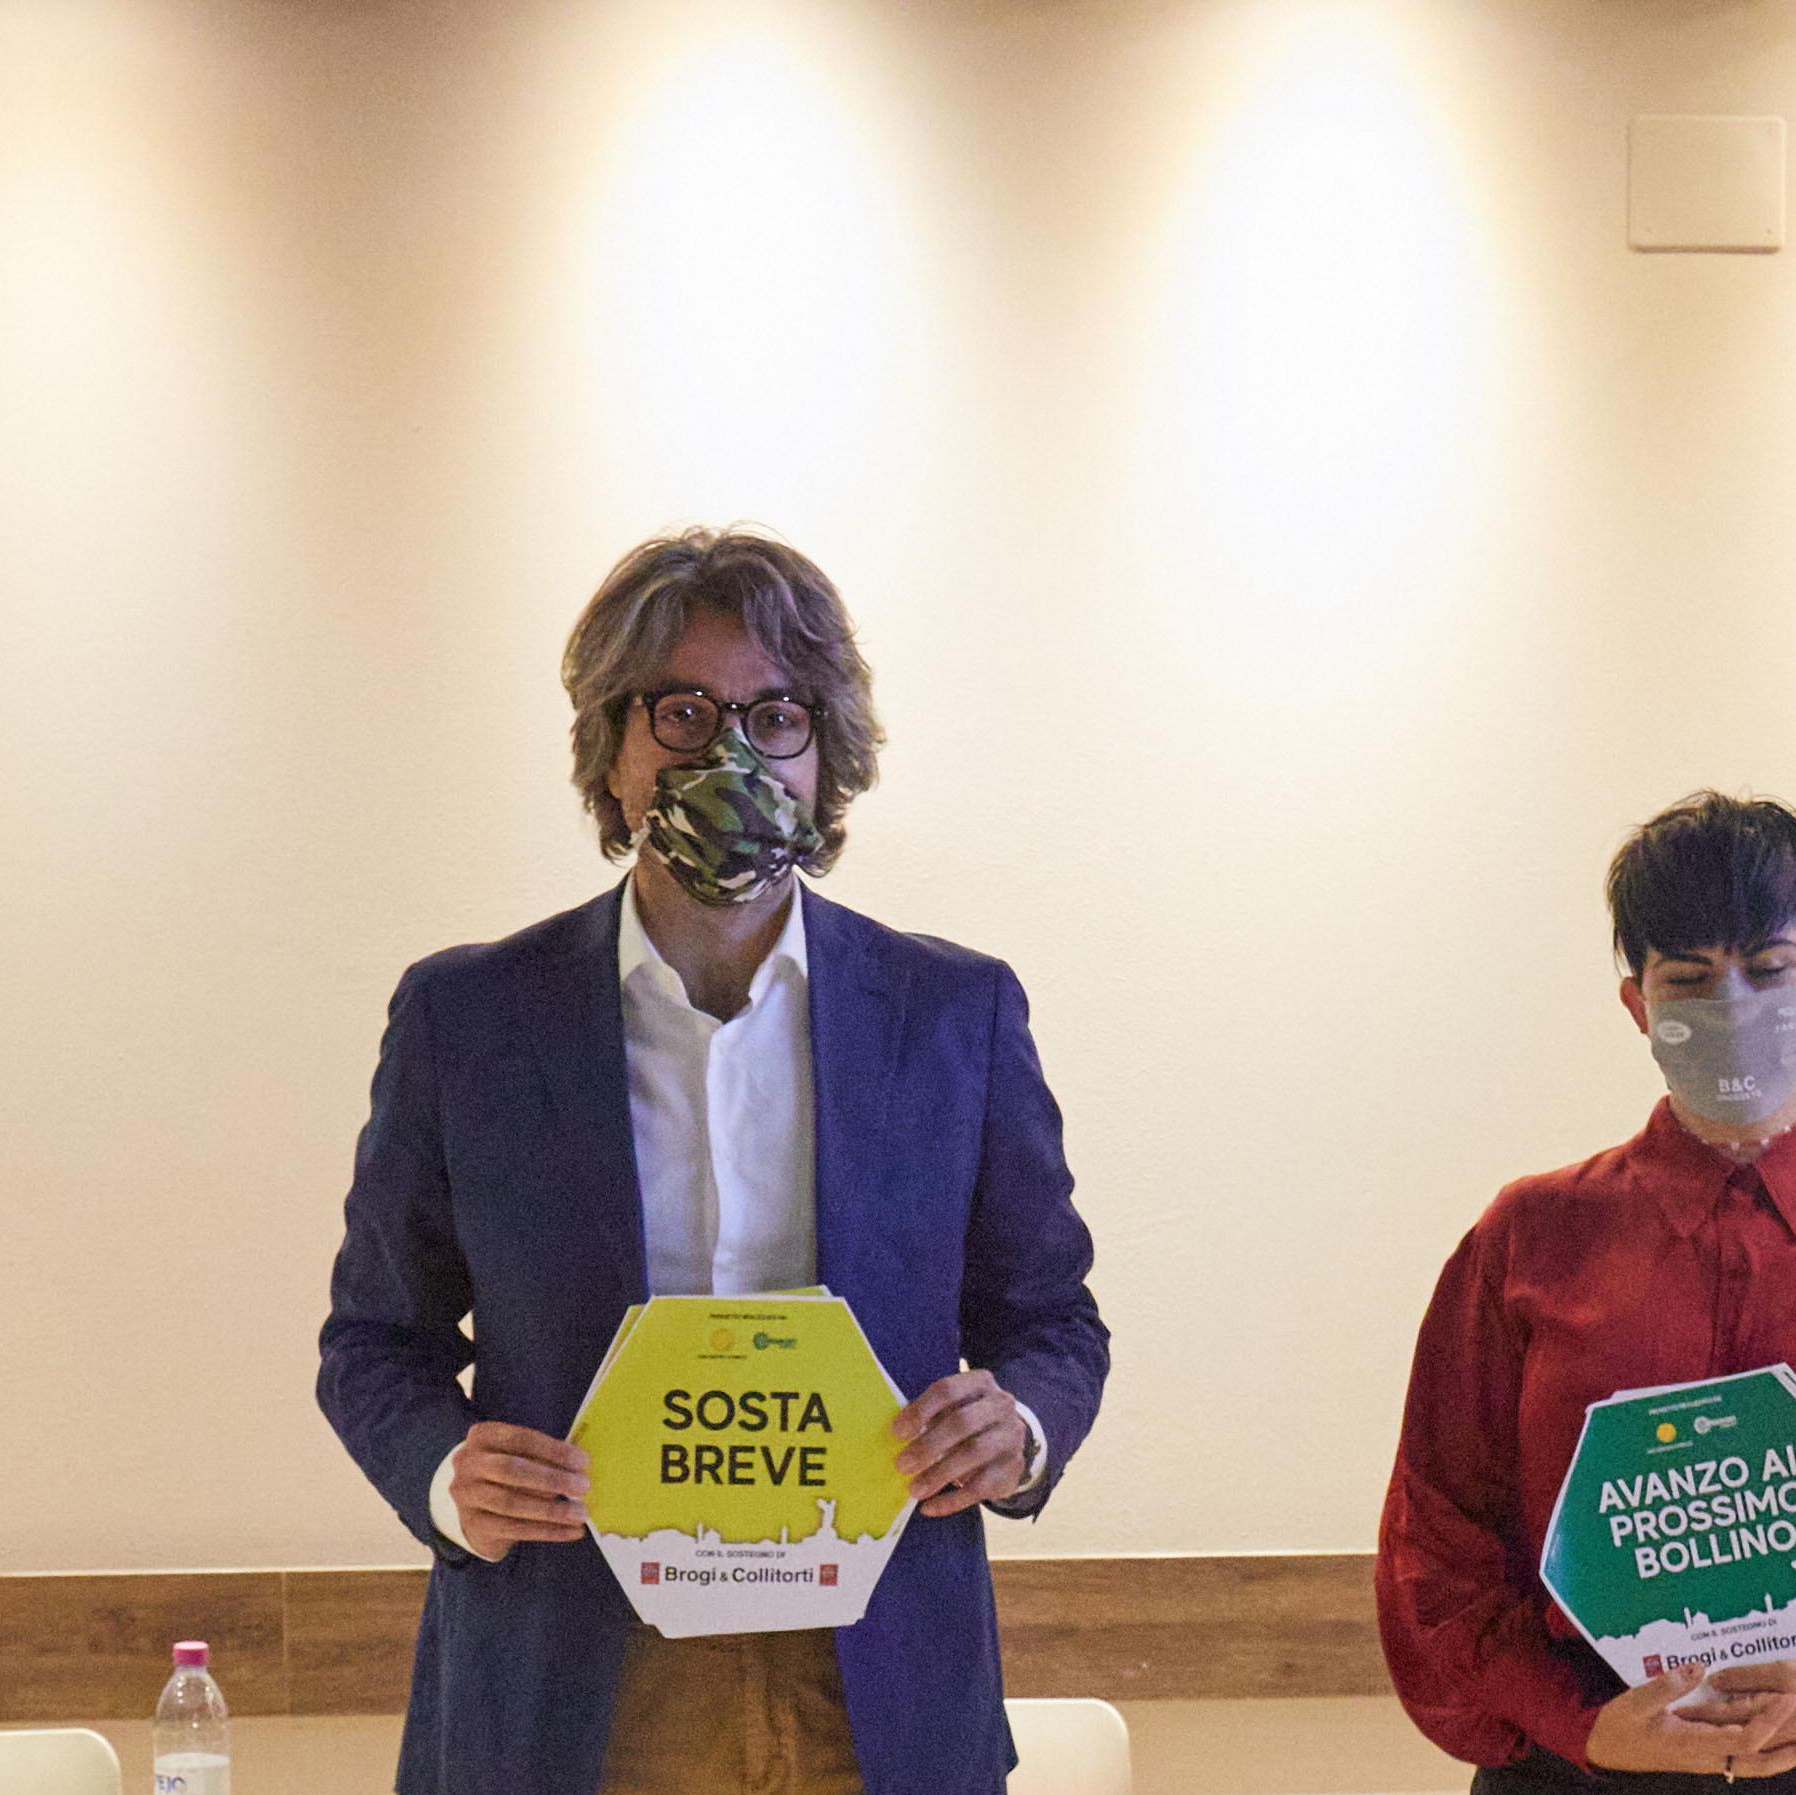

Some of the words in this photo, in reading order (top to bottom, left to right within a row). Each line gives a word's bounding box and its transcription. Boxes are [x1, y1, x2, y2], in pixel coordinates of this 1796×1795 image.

[662, 1389, 833, 1433] SOSTA
[660, 1444, 827, 1487] BREVE
[1598, 1457, 1749, 1514] AVANZO
[665, 1566, 716, 1586] Brogi
[719, 1572, 729, 1582] &
[732, 1567, 814, 1583] Collitorti
[1666, 1647, 1717, 1671] Brogi
[1720, 1652, 1728, 1661] &
